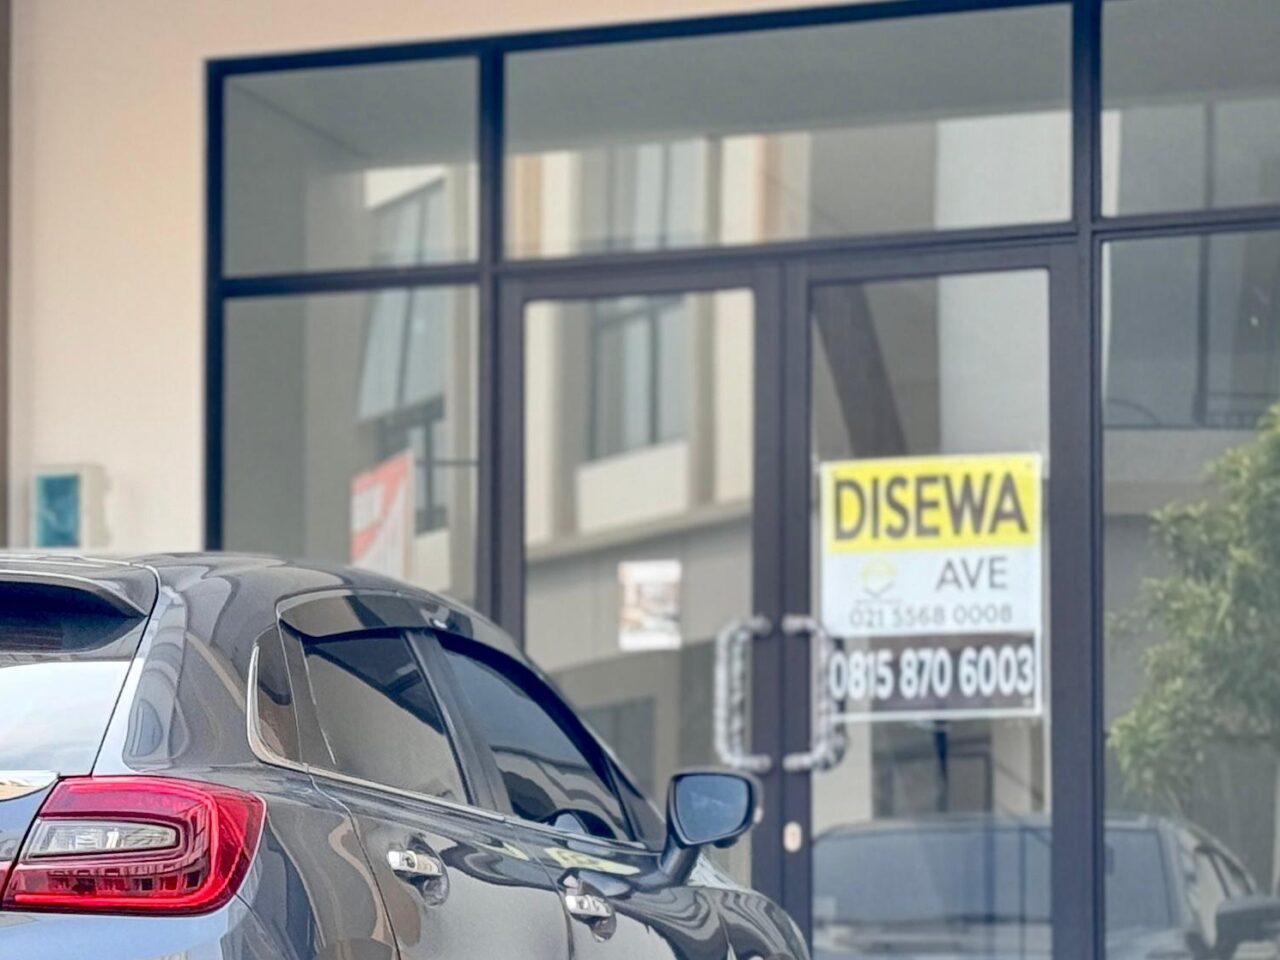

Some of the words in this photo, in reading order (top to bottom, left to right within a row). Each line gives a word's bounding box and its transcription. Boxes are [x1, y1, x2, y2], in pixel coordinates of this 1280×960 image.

[834, 472, 1029, 540] DISEWA
[935, 556, 1008, 591] AVE
[829, 650, 894, 701] 0815
[899, 647, 953, 699] 870
[959, 645, 1035, 697] 6003
